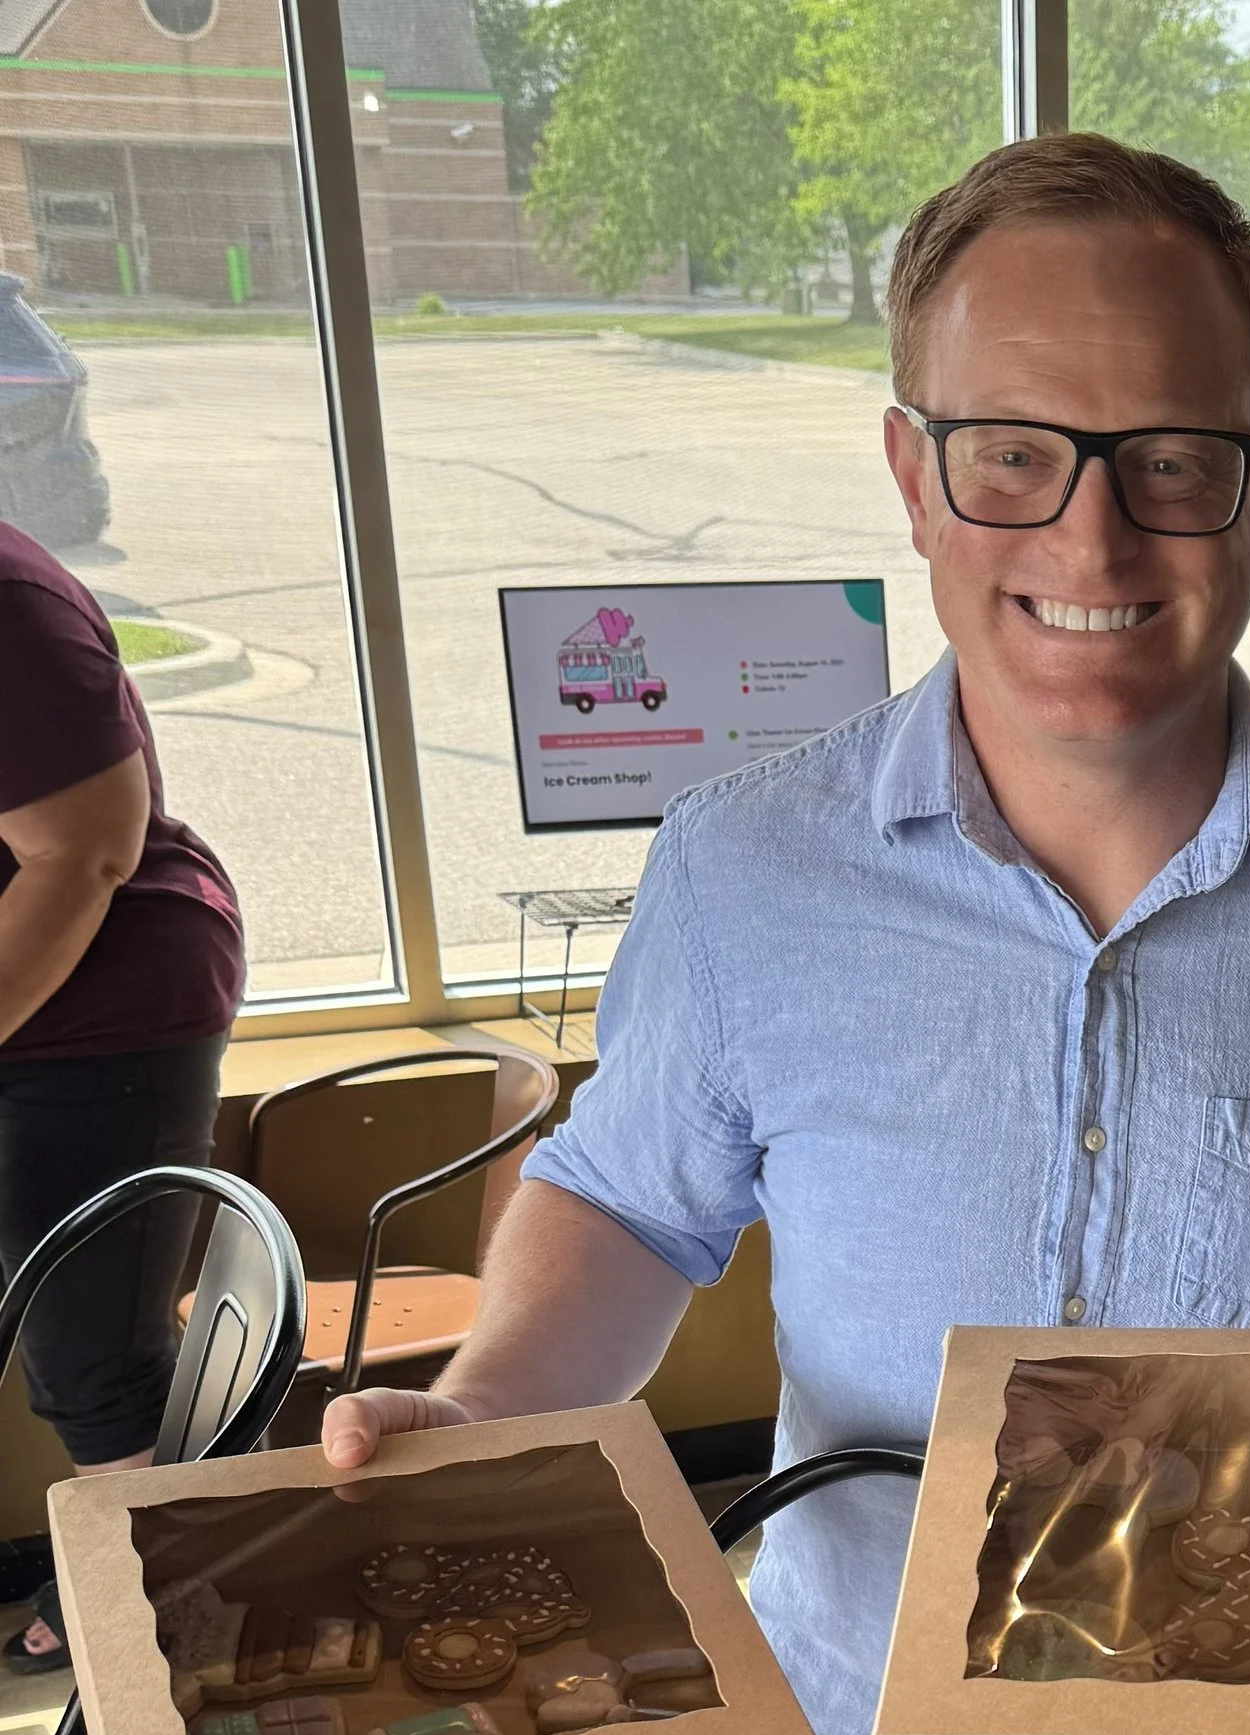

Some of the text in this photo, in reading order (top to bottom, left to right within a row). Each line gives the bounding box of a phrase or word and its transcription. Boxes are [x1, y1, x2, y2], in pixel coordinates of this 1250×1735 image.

[544, 769, 652, 788] Ice Cream Shop!
